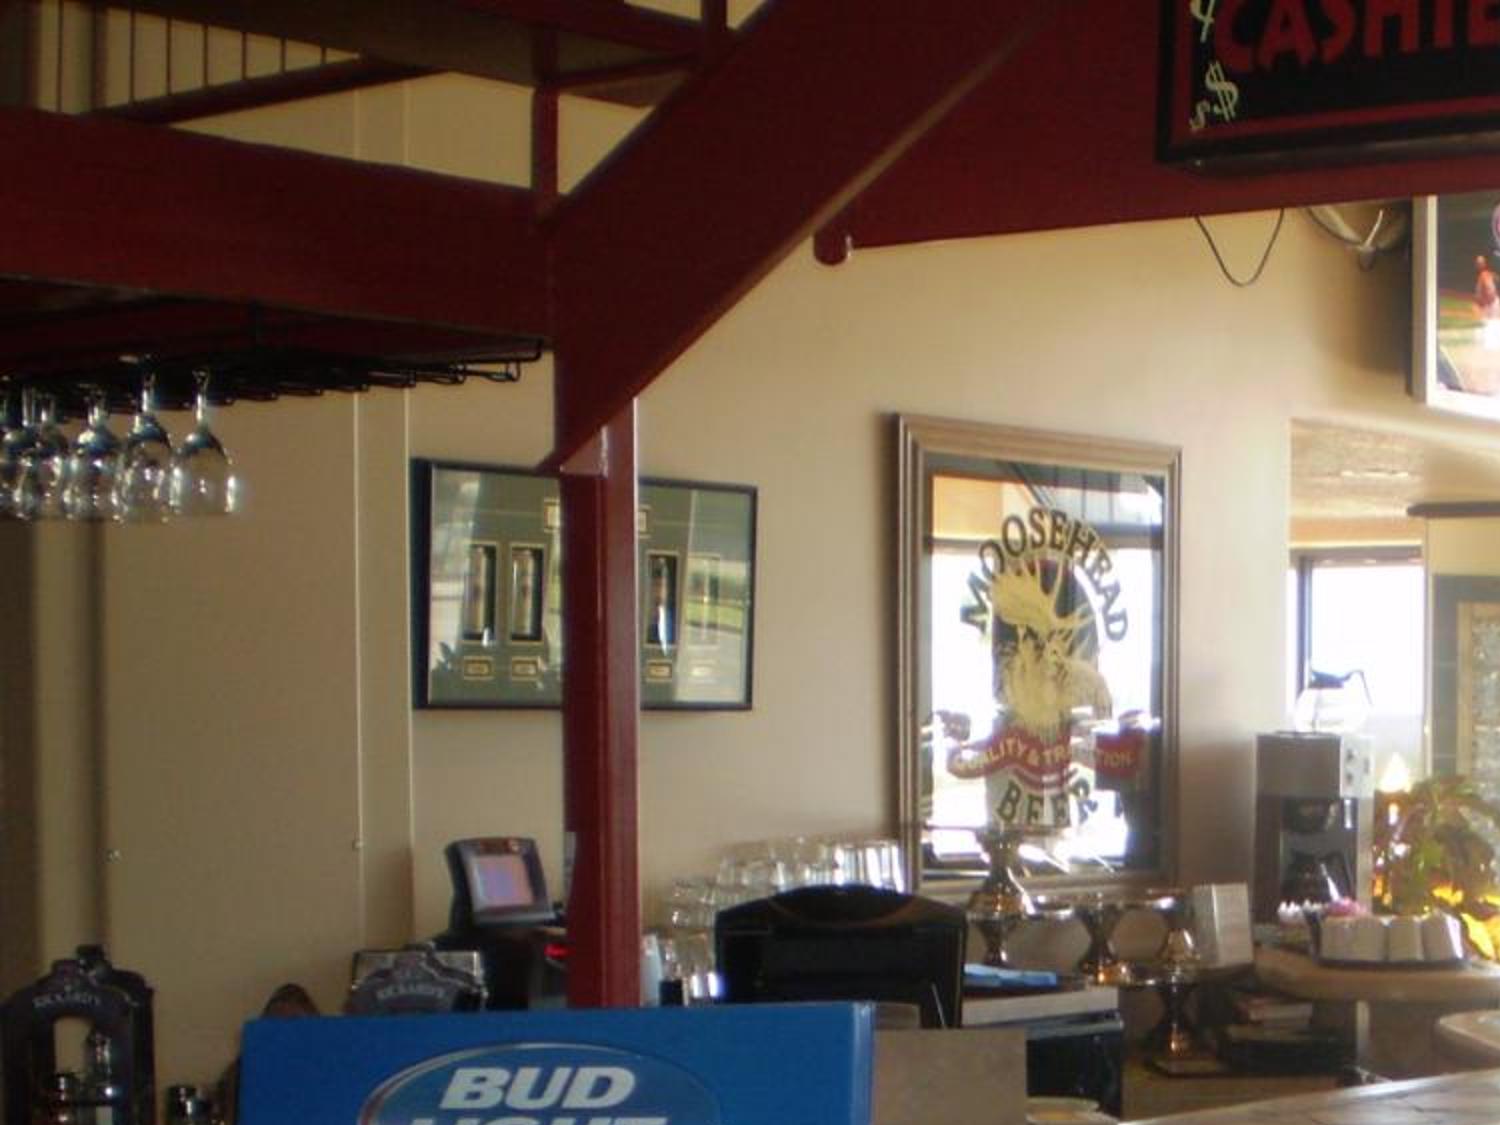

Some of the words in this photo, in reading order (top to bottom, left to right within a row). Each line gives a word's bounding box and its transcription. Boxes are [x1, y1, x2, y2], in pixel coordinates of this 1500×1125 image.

[959, 506, 1129, 643] MOOSEHEAD
[1042, 744, 1136, 768] TRATION
[996, 778, 1099, 824] BEER
[439, 1066, 637, 1109] BUD
